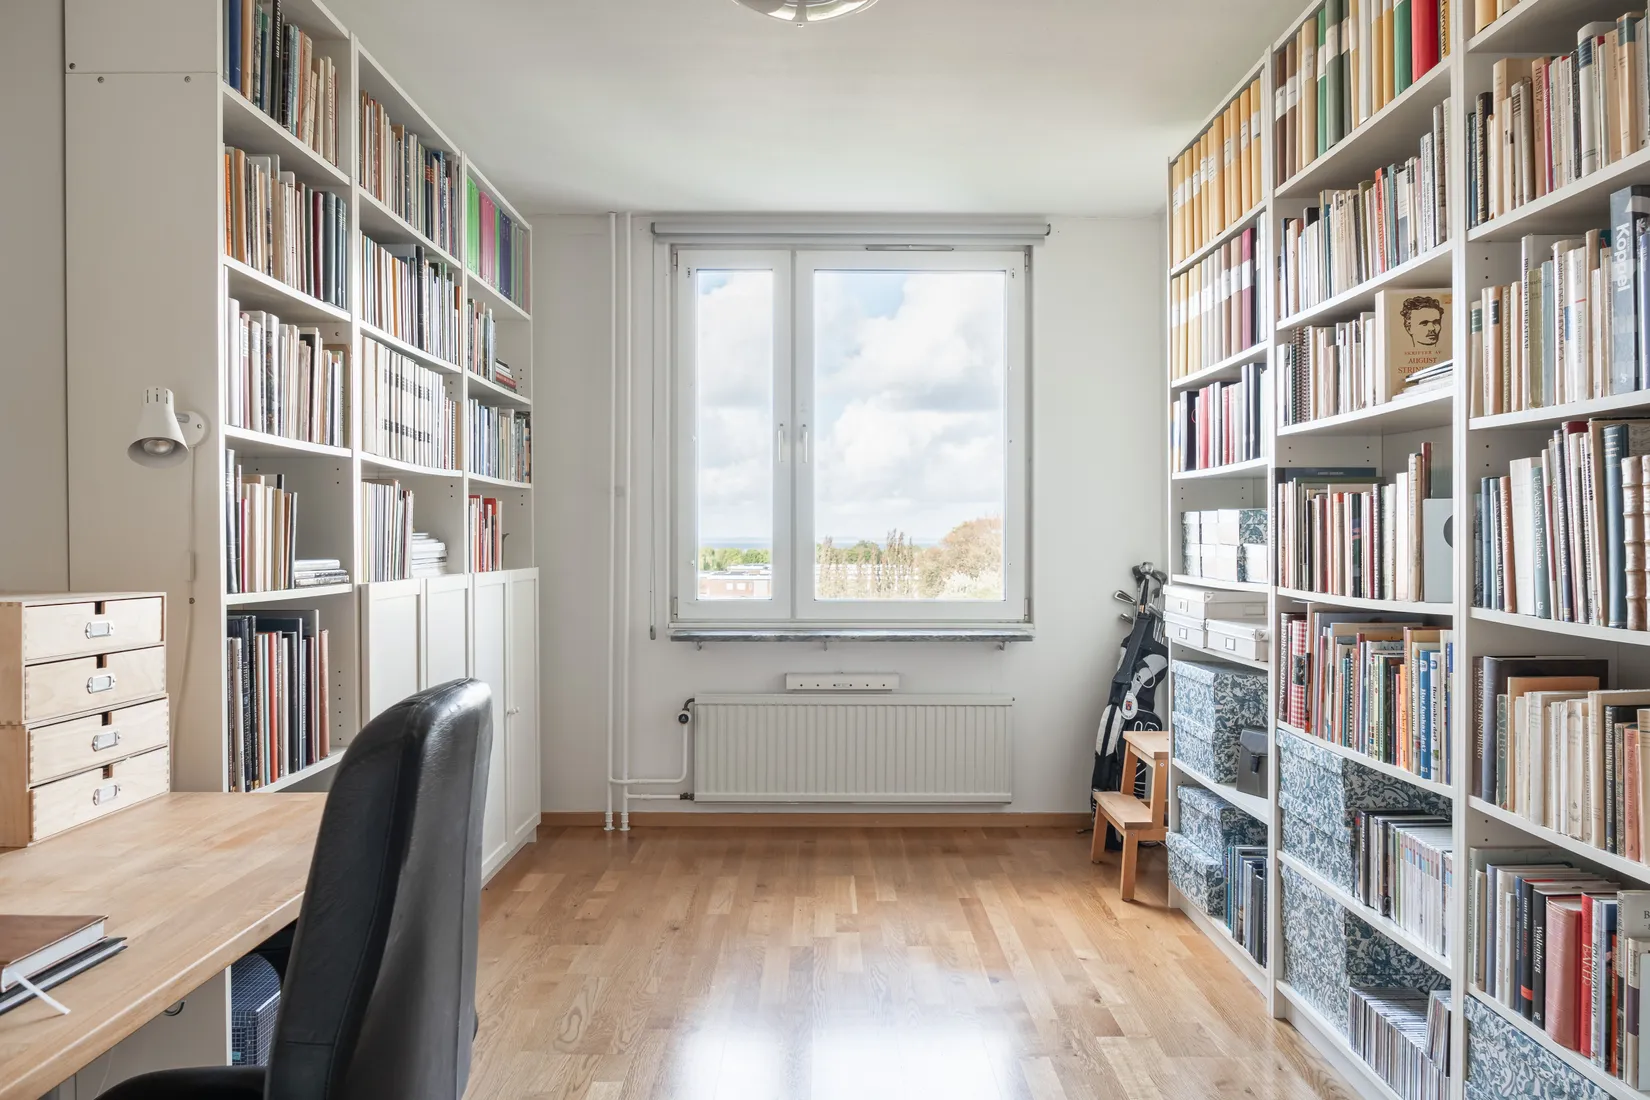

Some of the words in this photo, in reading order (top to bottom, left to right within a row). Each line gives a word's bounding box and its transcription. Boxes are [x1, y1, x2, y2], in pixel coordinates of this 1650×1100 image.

[1614, 222, 1630, 292] Koppel
[1533, 476, 1541, 489] Ulf
[1533, 489, 1542, 526] Adelsohn
[1535, 528, 1544, 569] Partiledare
[1534, 926, 1543, 974] Wallenberg
[1582, 944, 1591, 987] BAKER
